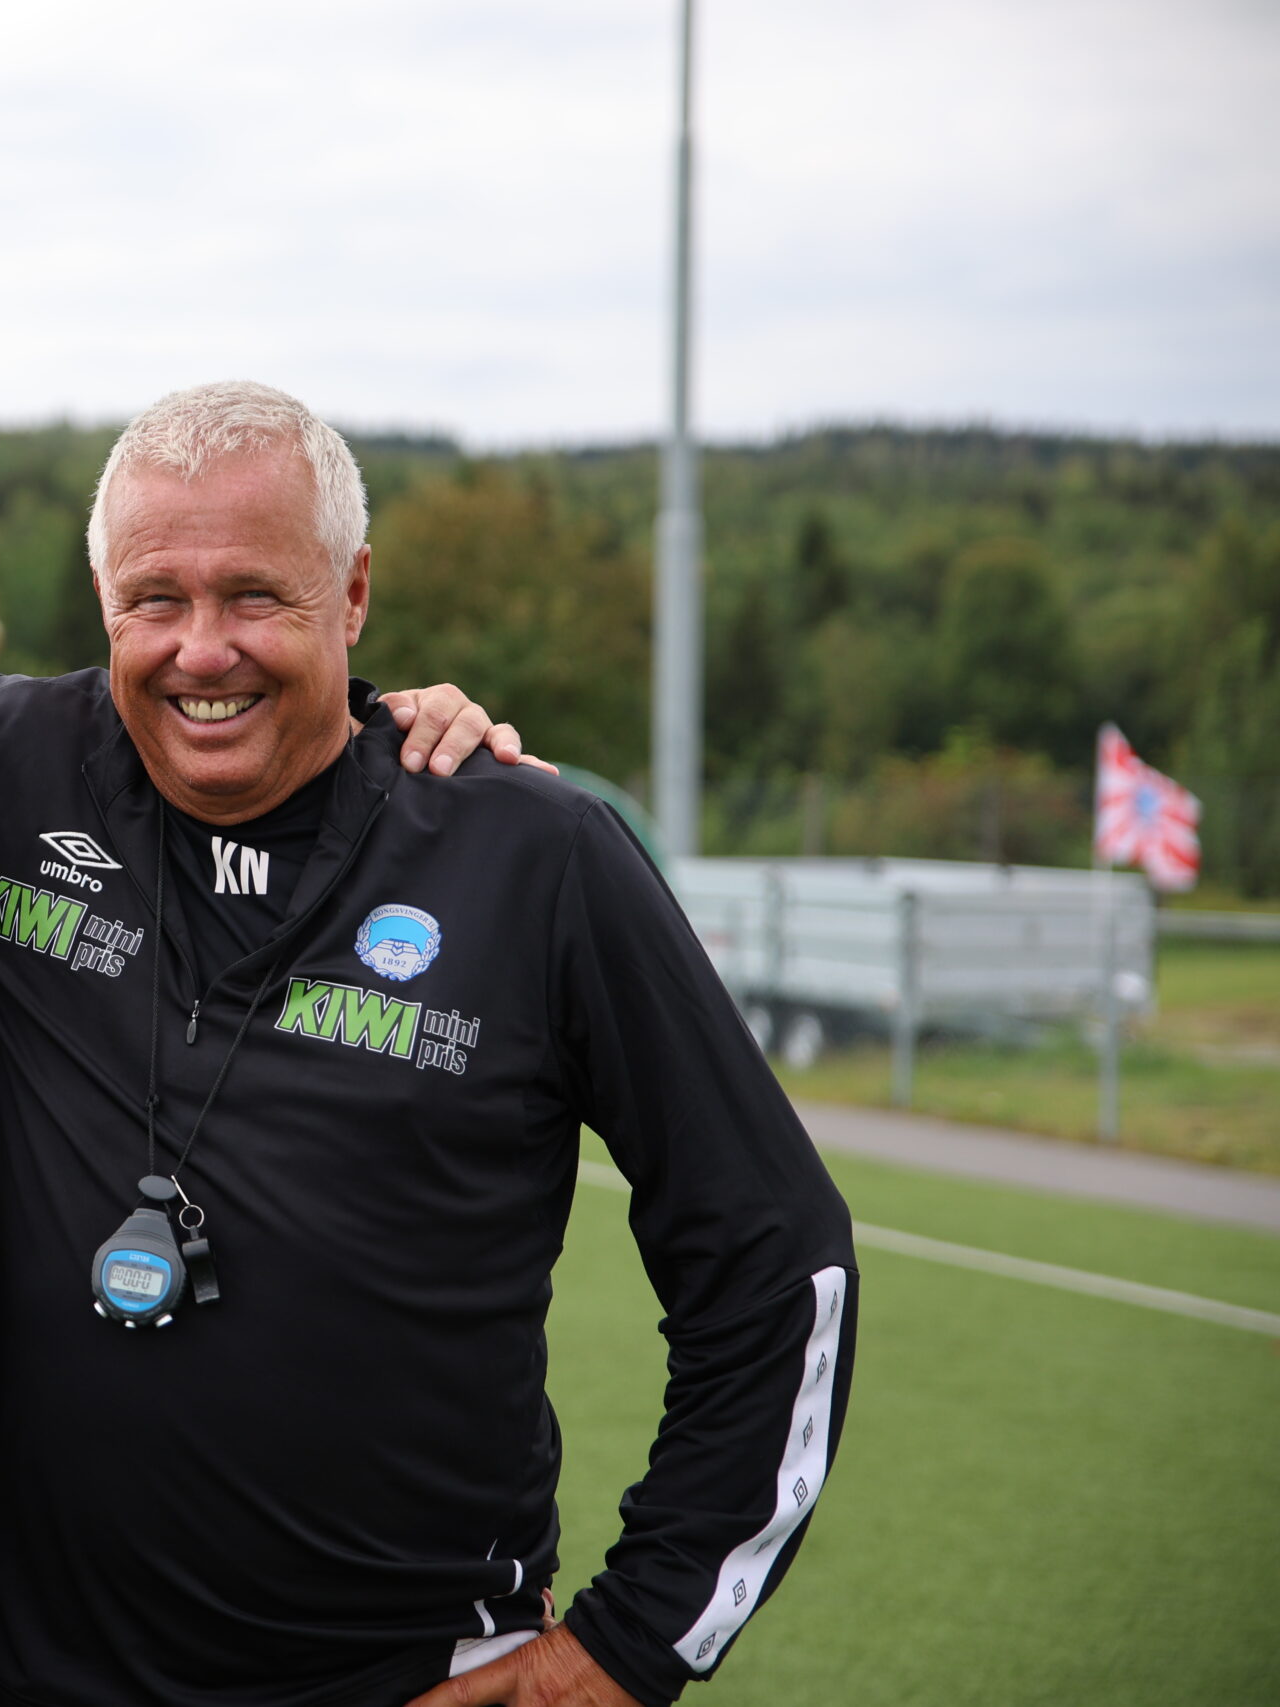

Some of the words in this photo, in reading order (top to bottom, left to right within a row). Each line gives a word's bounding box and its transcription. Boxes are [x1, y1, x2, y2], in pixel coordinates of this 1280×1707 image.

[40, 860, 103, 892] umbro
[211, 835, 270, 895] KN
[373, 907, 429, 923] KONGSVINGER
[83, 915, 144, 955] mini
[71, 942, 125, 977] pris
[382, 957, 407, 968] 1892
[274, 977, 422, 1059] KIWI
[423, 1009, 480, 1048] mini
[416, 1038, 467, 1074] pris
